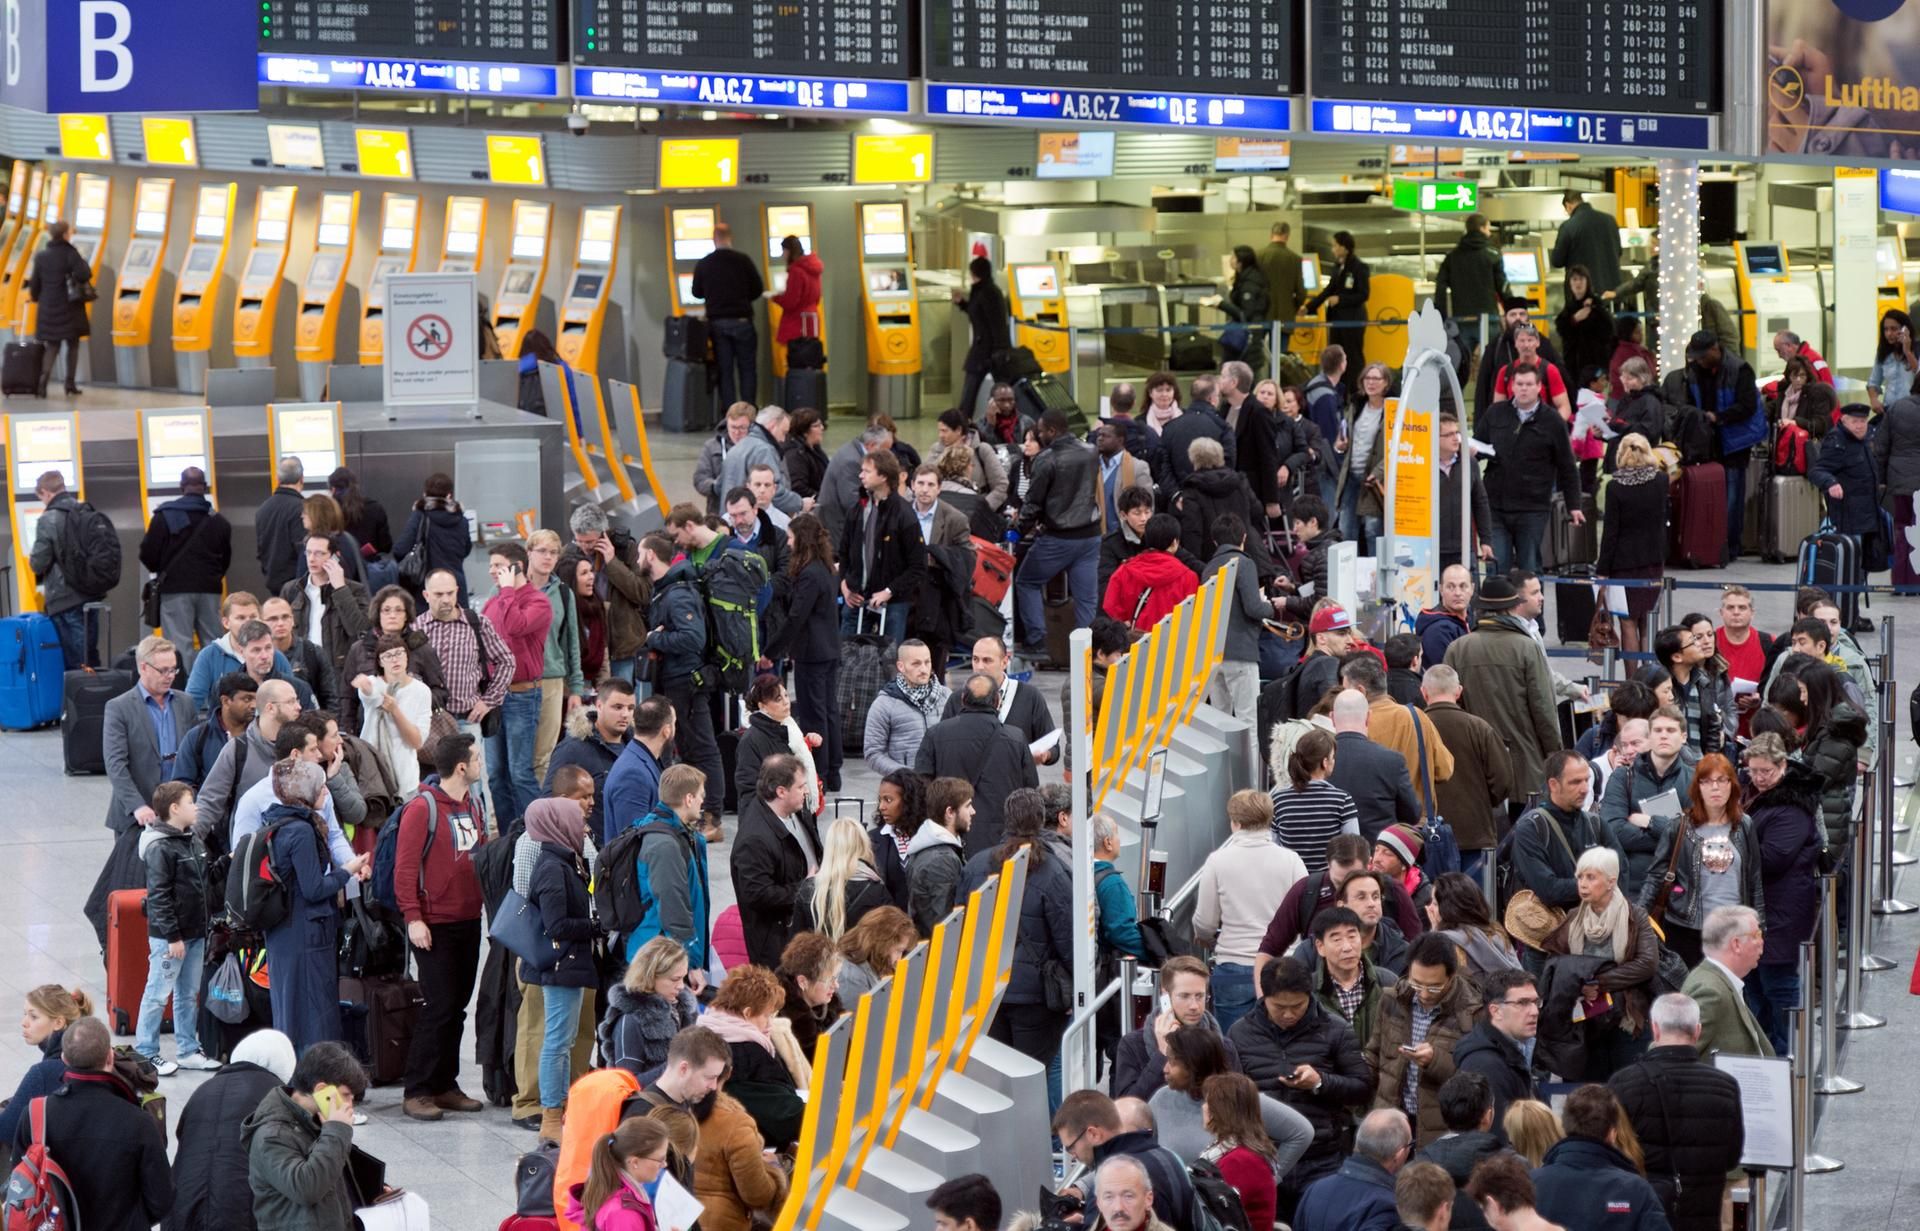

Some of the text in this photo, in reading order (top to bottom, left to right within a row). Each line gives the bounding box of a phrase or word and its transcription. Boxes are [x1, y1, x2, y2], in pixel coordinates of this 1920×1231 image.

[802, 6, 810, 18] 2
[1006, 0, 1266, 20] MADRID 2 D 857-859 E
[1342, 10, 1684, 32] LH 1238 WIEN 1 A 260-338 A
[1400, 0, 1696, 18] SINGAPUR 1 C 713-720 B46
[646, 14, 678, 26] DUBLIN
[804, 20, 808, 32] 1
[818, 22, 826, 32] A
[952, 12, 964, 22] LH
[1006, 14, 1088, 29] LONDON-HEATHROW
[1178, 20, 1182, 30] 1
[1192, 20, 1200, 30] A
[1210, 22, 1250, 34] 260-338
[1262, 22, 1280, 34] B30
[79, 0, 134, 92] B
[646, 30, 698, 43] MANCHESTER
[804, 34, 810, 46] 1
[818, 36, 826, 46] A
[952, 26, 964, 38] LH
[1006, 28, 1072, 42] MALABO-ABUJA
[1178, 34, 1182, 46] 1
[1194, 36, 1200, 46] A
[1210, 36, 1250, 48] 260-338
[1262, 38, 1280, 50] B25
[1342, 26, 1684, 50] FB 438 SOFIA 1 C 701-702 B
[648, 42, 682, 54] SEATTLE
[804, 50, 810, 60] 1
[818, 50, 826, 60] A
[980, 42, 996, 54] 232
[1006, 44, 1056, 56] TASCHKENT
[1176, 50, 1182, 62] 2
[1194, 50, 1200, 62] D
[1210, 52, 1250, 64] 891-893
[1262, 52, 1274, 64] E6
[1342, 42, 1686, 66] KL 1766 AMSTERDAM 2 D 801-804 D
[952, 56, 1278, 80] UA 051 NEW YORK-NEWARK 1 B 501-506 Z21
[1342, 56, 1684, 80] EN 8224 VERONA 1 A 260-338 B
[1342, 72, 1666, 96] LH 1464 N.NOVGOROD-ANNULLIER 1 A 260-338
[1825, 74, 1920, 111] Luftha
[1062, 94, 1120, 120] A,B,C,Z
[1170, 98, 1197, 124] D,E
[1459, 111, 1523, 139] A,B,C,Z
[1578, 117, 1606, 143] D,E
[96, 132, 108, 156] 1
[180, 138, 192, 161] 1
[395, 150, 408, 174] 1
[527, 155, 540, 181] 1
[716, 158, 731, 182] 1
[911, 153, 924, 177] 1
